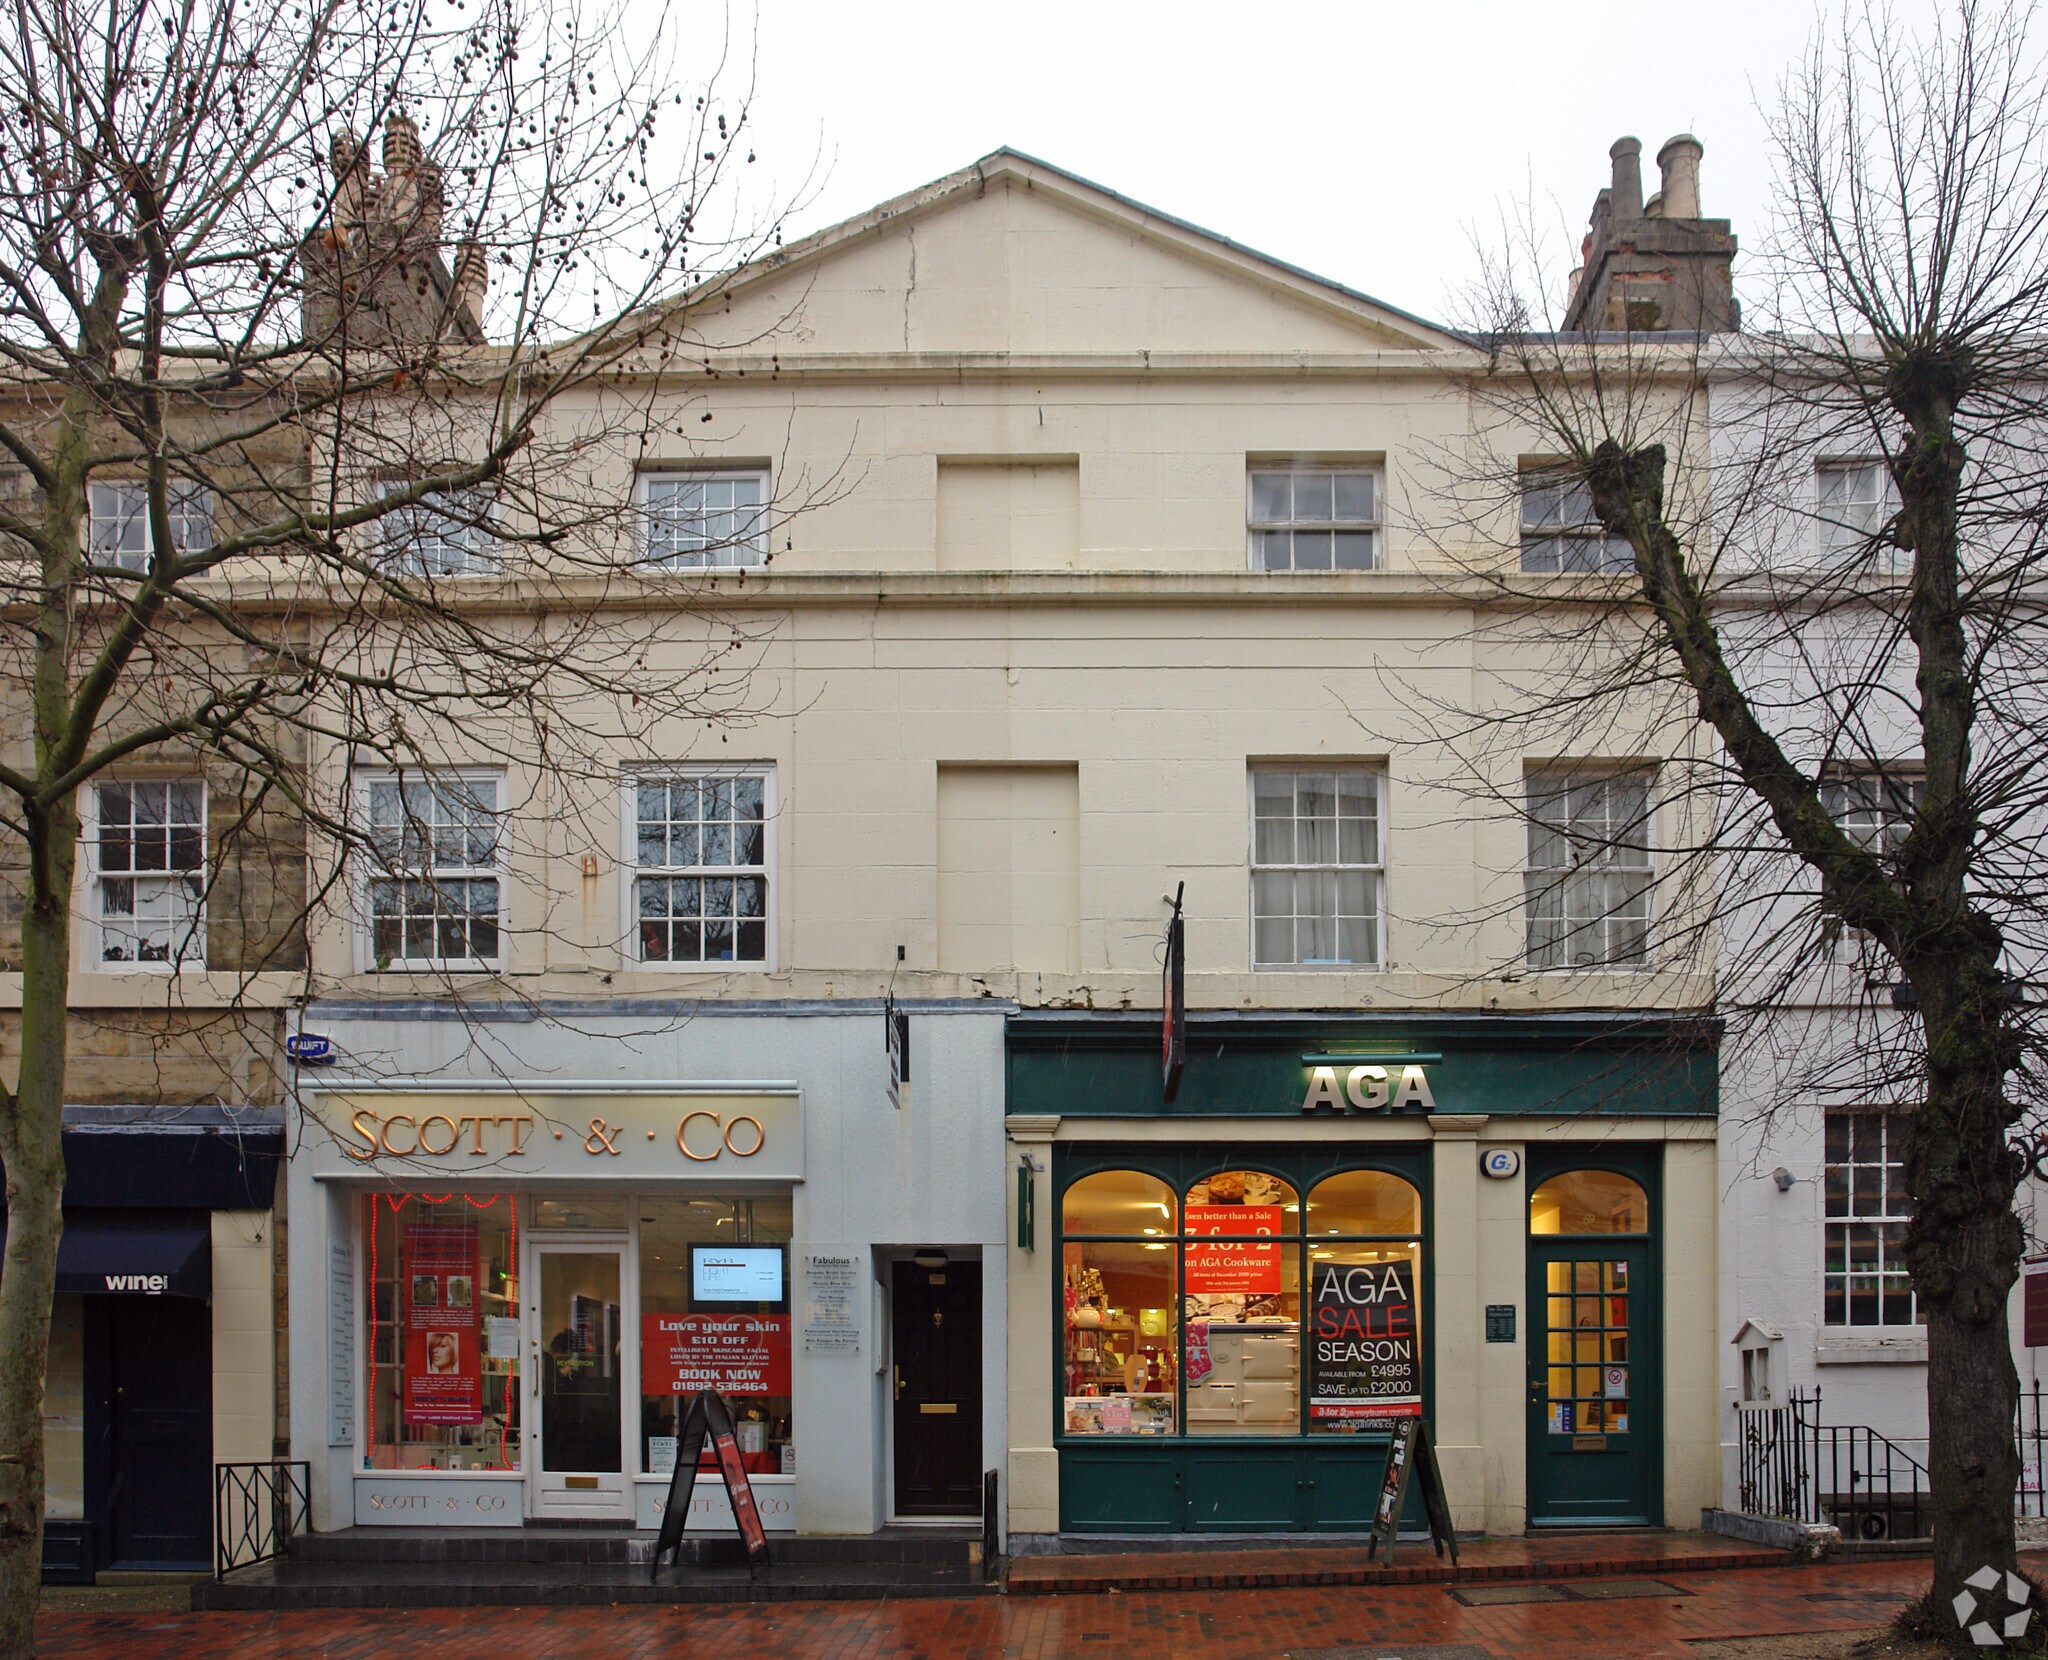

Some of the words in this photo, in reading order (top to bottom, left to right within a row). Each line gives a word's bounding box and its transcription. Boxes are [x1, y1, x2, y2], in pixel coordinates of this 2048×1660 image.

[1302, 1064, 1436, 1109] AGA
[351, 1110, 534, 1160] SCOTT
[584, 1117, 623, 1156] &
[1185, 1212, 1202, 1220] Even
[1204, 1212, 1227, 1220] better
[1229, 1212, 1247, 1220] than
[1255, 1212, 1272, 1220] Sale
[1256, 1227, 1272, 1250] 2
[813, 1256, 850, 1264] Fabulous
[1185, 1259, 1197, 1267] on
[1200, 1258, 1221, 1267] AGA
[1223, 1257, 1272, 1267] Cookware
[105, 1274, 163, 1290] wine
[1318, 1265, 1408, 1304] AGA
[660, 1320, 697, 1331] Love
[702, 1322, 740, 1334] your
[745, 1320, 780, 1332] skin
[1317, 1305, 1410, 1339] SALE
[692, 1336, 718, 1344] £10
[722, 1336, 748, 1344] OFF
[1317, 1340, 1411, 1362] SEASON
[679, 1369, 721, 1380] BOOK
[726, 1369, 761, 1380] NOW
[1371, 1364, 1411, 1377] £4995
[672, 1381, 713, 1391] 01892
[715, 1382, 768, 1391] 536464
[1318, 1384, 1346, 1394] SAVE
[1370, 1380, 1411, 1394] £2000
[1326, 1408, 1339, 1416] for
[1327, 1421, 1394, 1430] www.agalinks.co
[370, 1493, 430, 1510] SCOTT
[446, 1497, 458, 1510] &
[653, 1498, 713, 1514] STT
